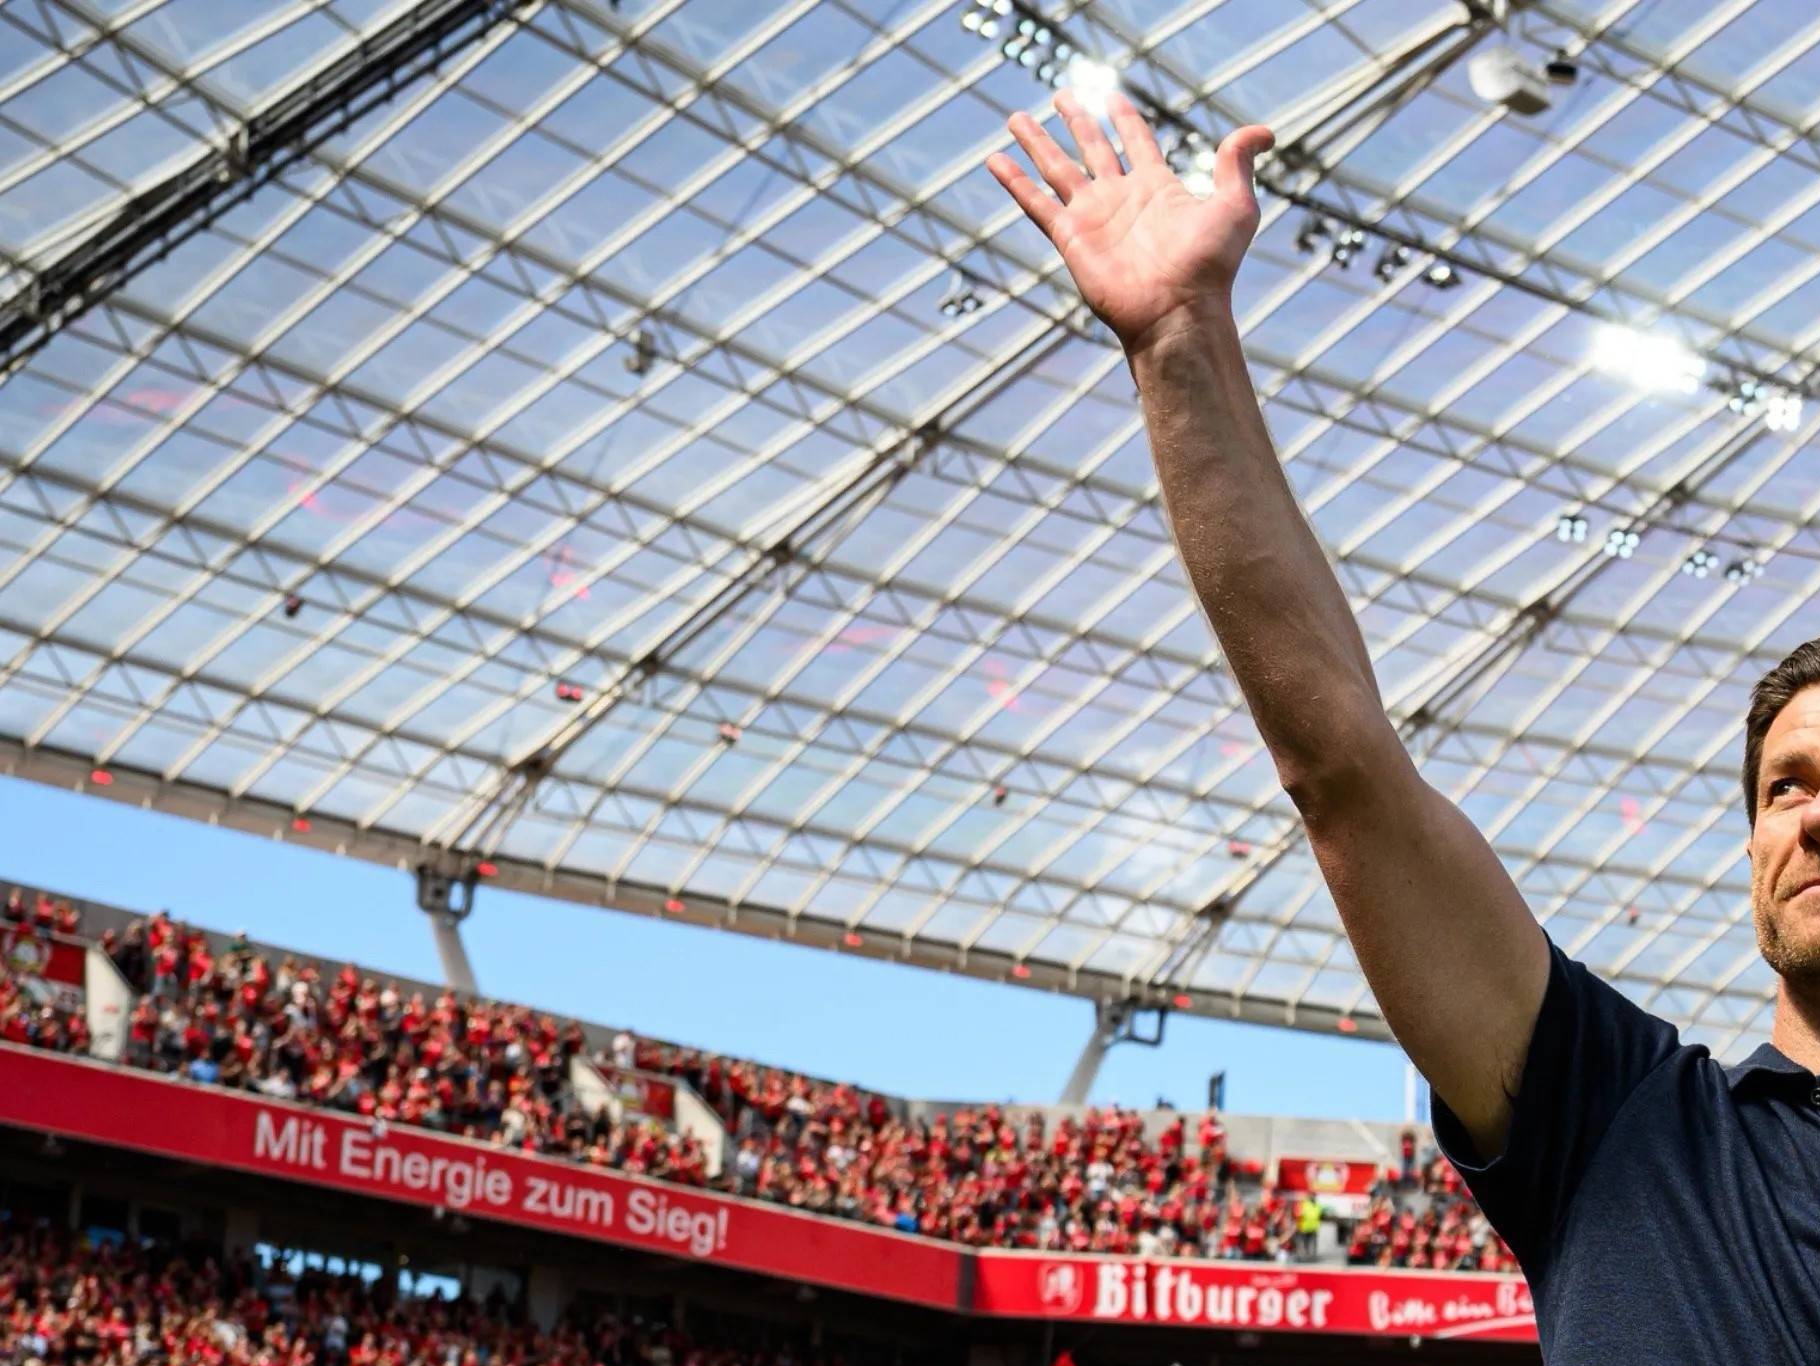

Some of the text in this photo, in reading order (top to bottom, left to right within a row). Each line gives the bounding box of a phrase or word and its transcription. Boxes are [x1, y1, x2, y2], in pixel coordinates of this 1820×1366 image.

[254, 1110, 728, 1257] Mit Energie zum Sieg!
[1093, 1263, 1334, 1327] Bitburger
